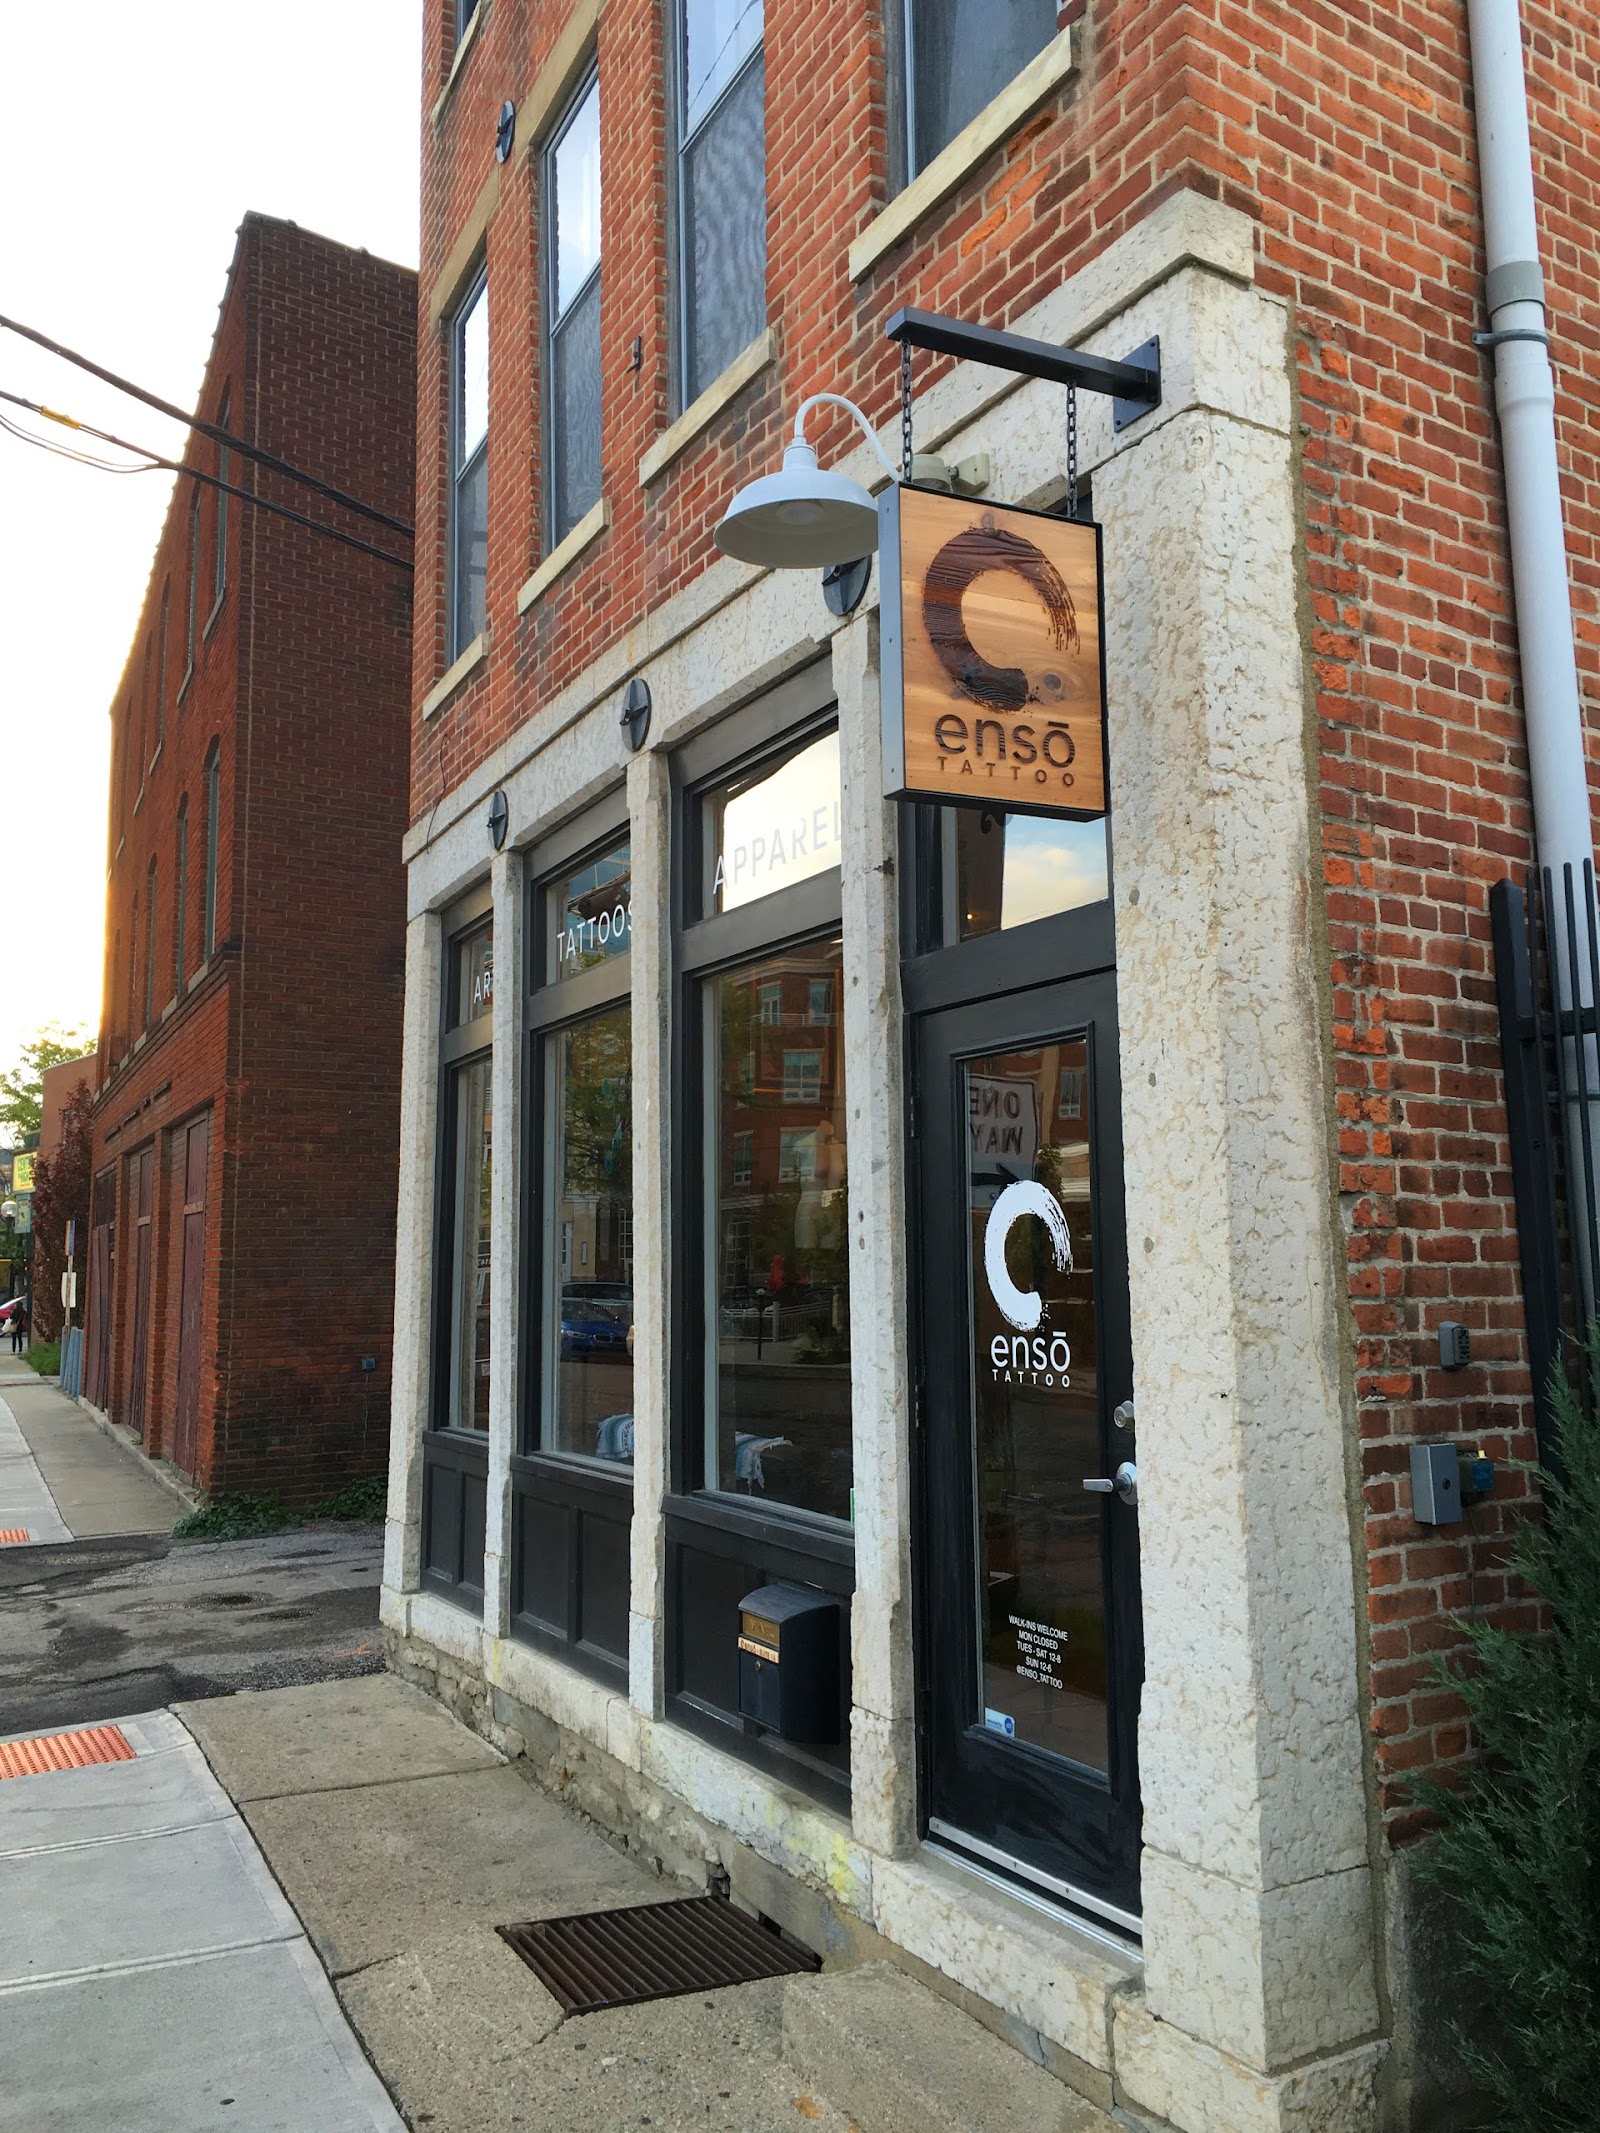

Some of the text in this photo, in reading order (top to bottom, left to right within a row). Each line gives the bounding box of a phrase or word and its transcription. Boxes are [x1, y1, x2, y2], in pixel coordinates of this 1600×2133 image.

[937, 756, 1075, 787] TATTOO
[713, 801, 841, 895] APPAREL
[992, 1368, 1070, 1388] TATTOO
[1008, 1614, 1069, 1641] WALK-INS WELCOME
[1016, 1640, 1033, 1654] TUES
[1036, 1647, 1048, 1659] SAT
[1018, 1629, 1059, 1650] MON CLOSED
[1025, 1656, 1039, 1669] SUN
[1016, 1664, 1063, 1689] @ENSO_TATTOO
